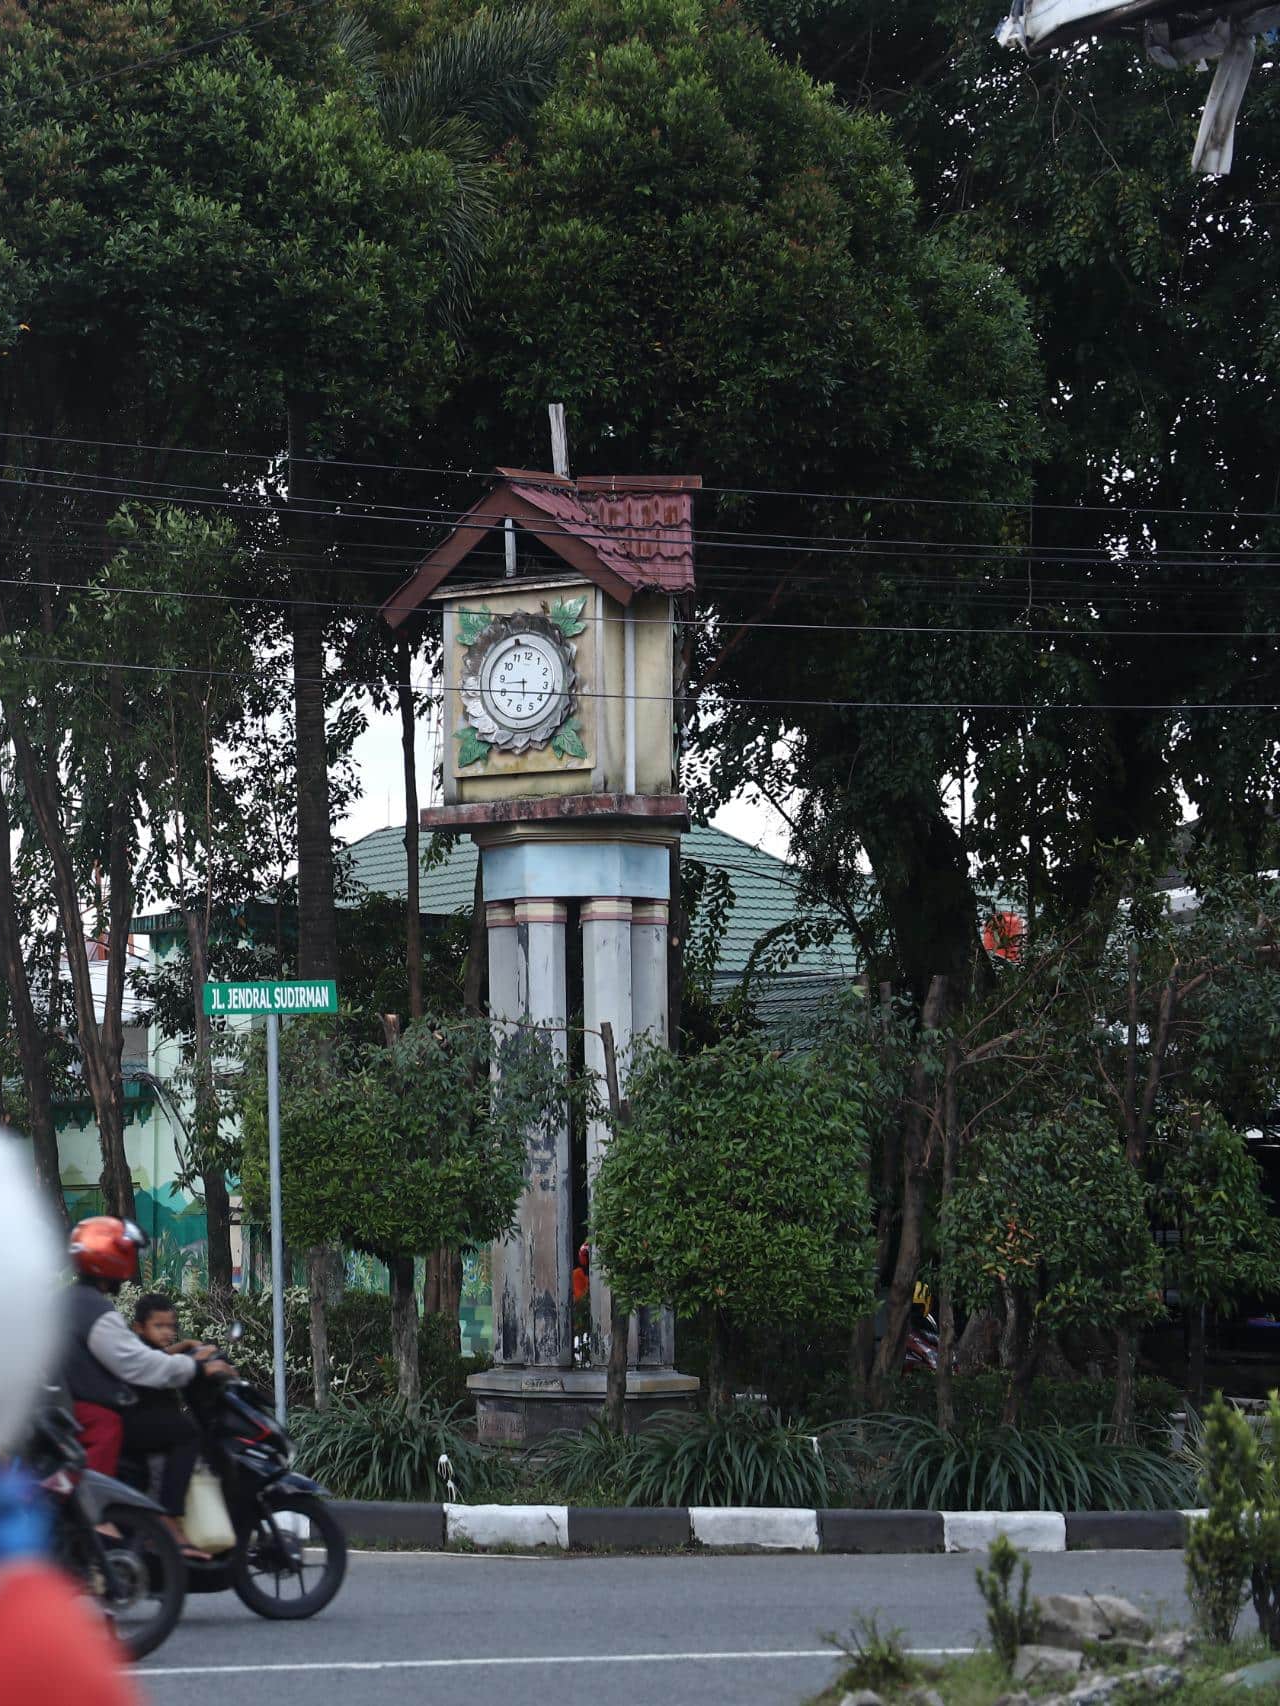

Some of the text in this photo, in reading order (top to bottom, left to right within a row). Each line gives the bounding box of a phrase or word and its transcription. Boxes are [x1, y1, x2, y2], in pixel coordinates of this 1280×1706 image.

[525, 652, 532, 660] 12
[504, 662, 513, 671] 10
[507, 699, 512, 707] 7
[212, 986, 328, 1009] JL. JENDRAL SUDIRMAN
